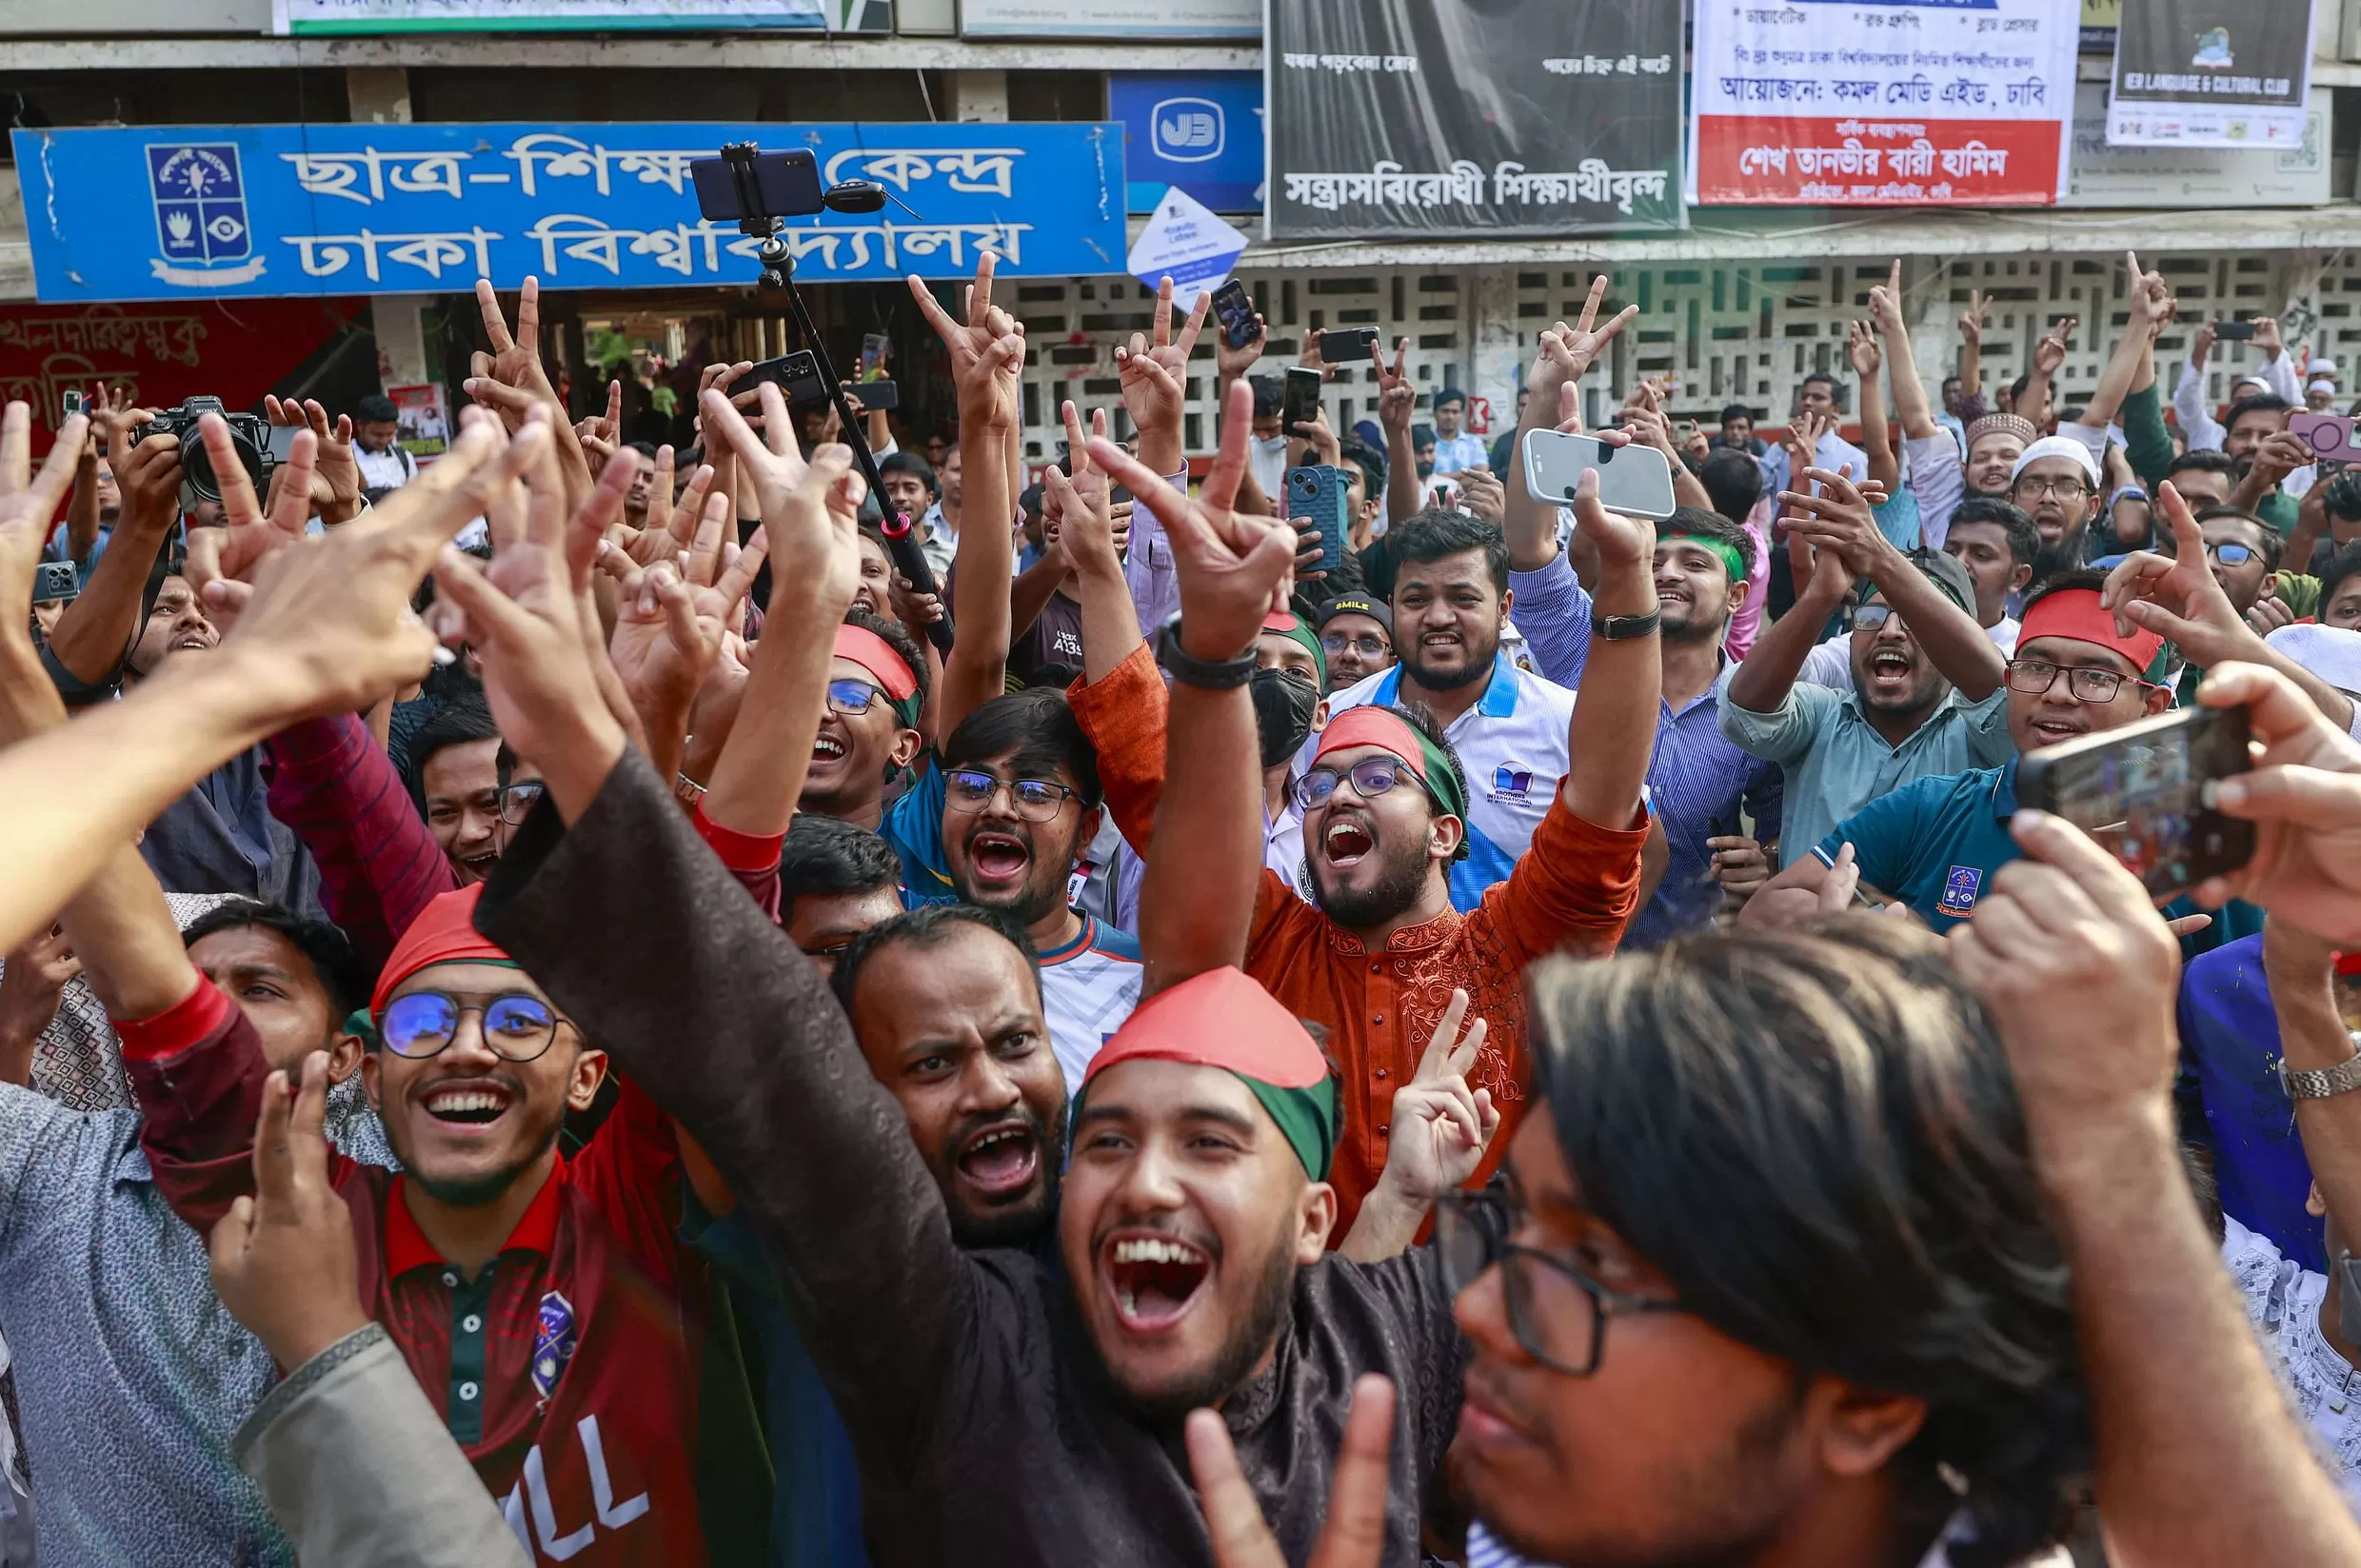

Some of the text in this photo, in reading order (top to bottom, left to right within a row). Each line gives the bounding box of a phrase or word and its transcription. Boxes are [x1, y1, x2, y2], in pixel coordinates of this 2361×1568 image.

[1831, 78, 1880, 104] কমল
[1886, 73, 1934, 104] মেডি
[2006, 75, 2049, 108] ঢাবি
[279, 133, 1025, 206] ছাত্র-শিক্ষ কেন্দ্র
[1739, 138, 2009, 178] শেখ তানভীর বারী হামিম
[1283, 158, 1668, 215] সন্ত্রাসবিরোধী শিক্ষার্থীবৃন্দ
[280, 225, 504, 283] ঢাকা
[1335, 601, 1370, 611] SMILE
[1486, 793, 1533, 805] INTERNATIONAL
[1495, 790, 1525, 800] BROTHERS
